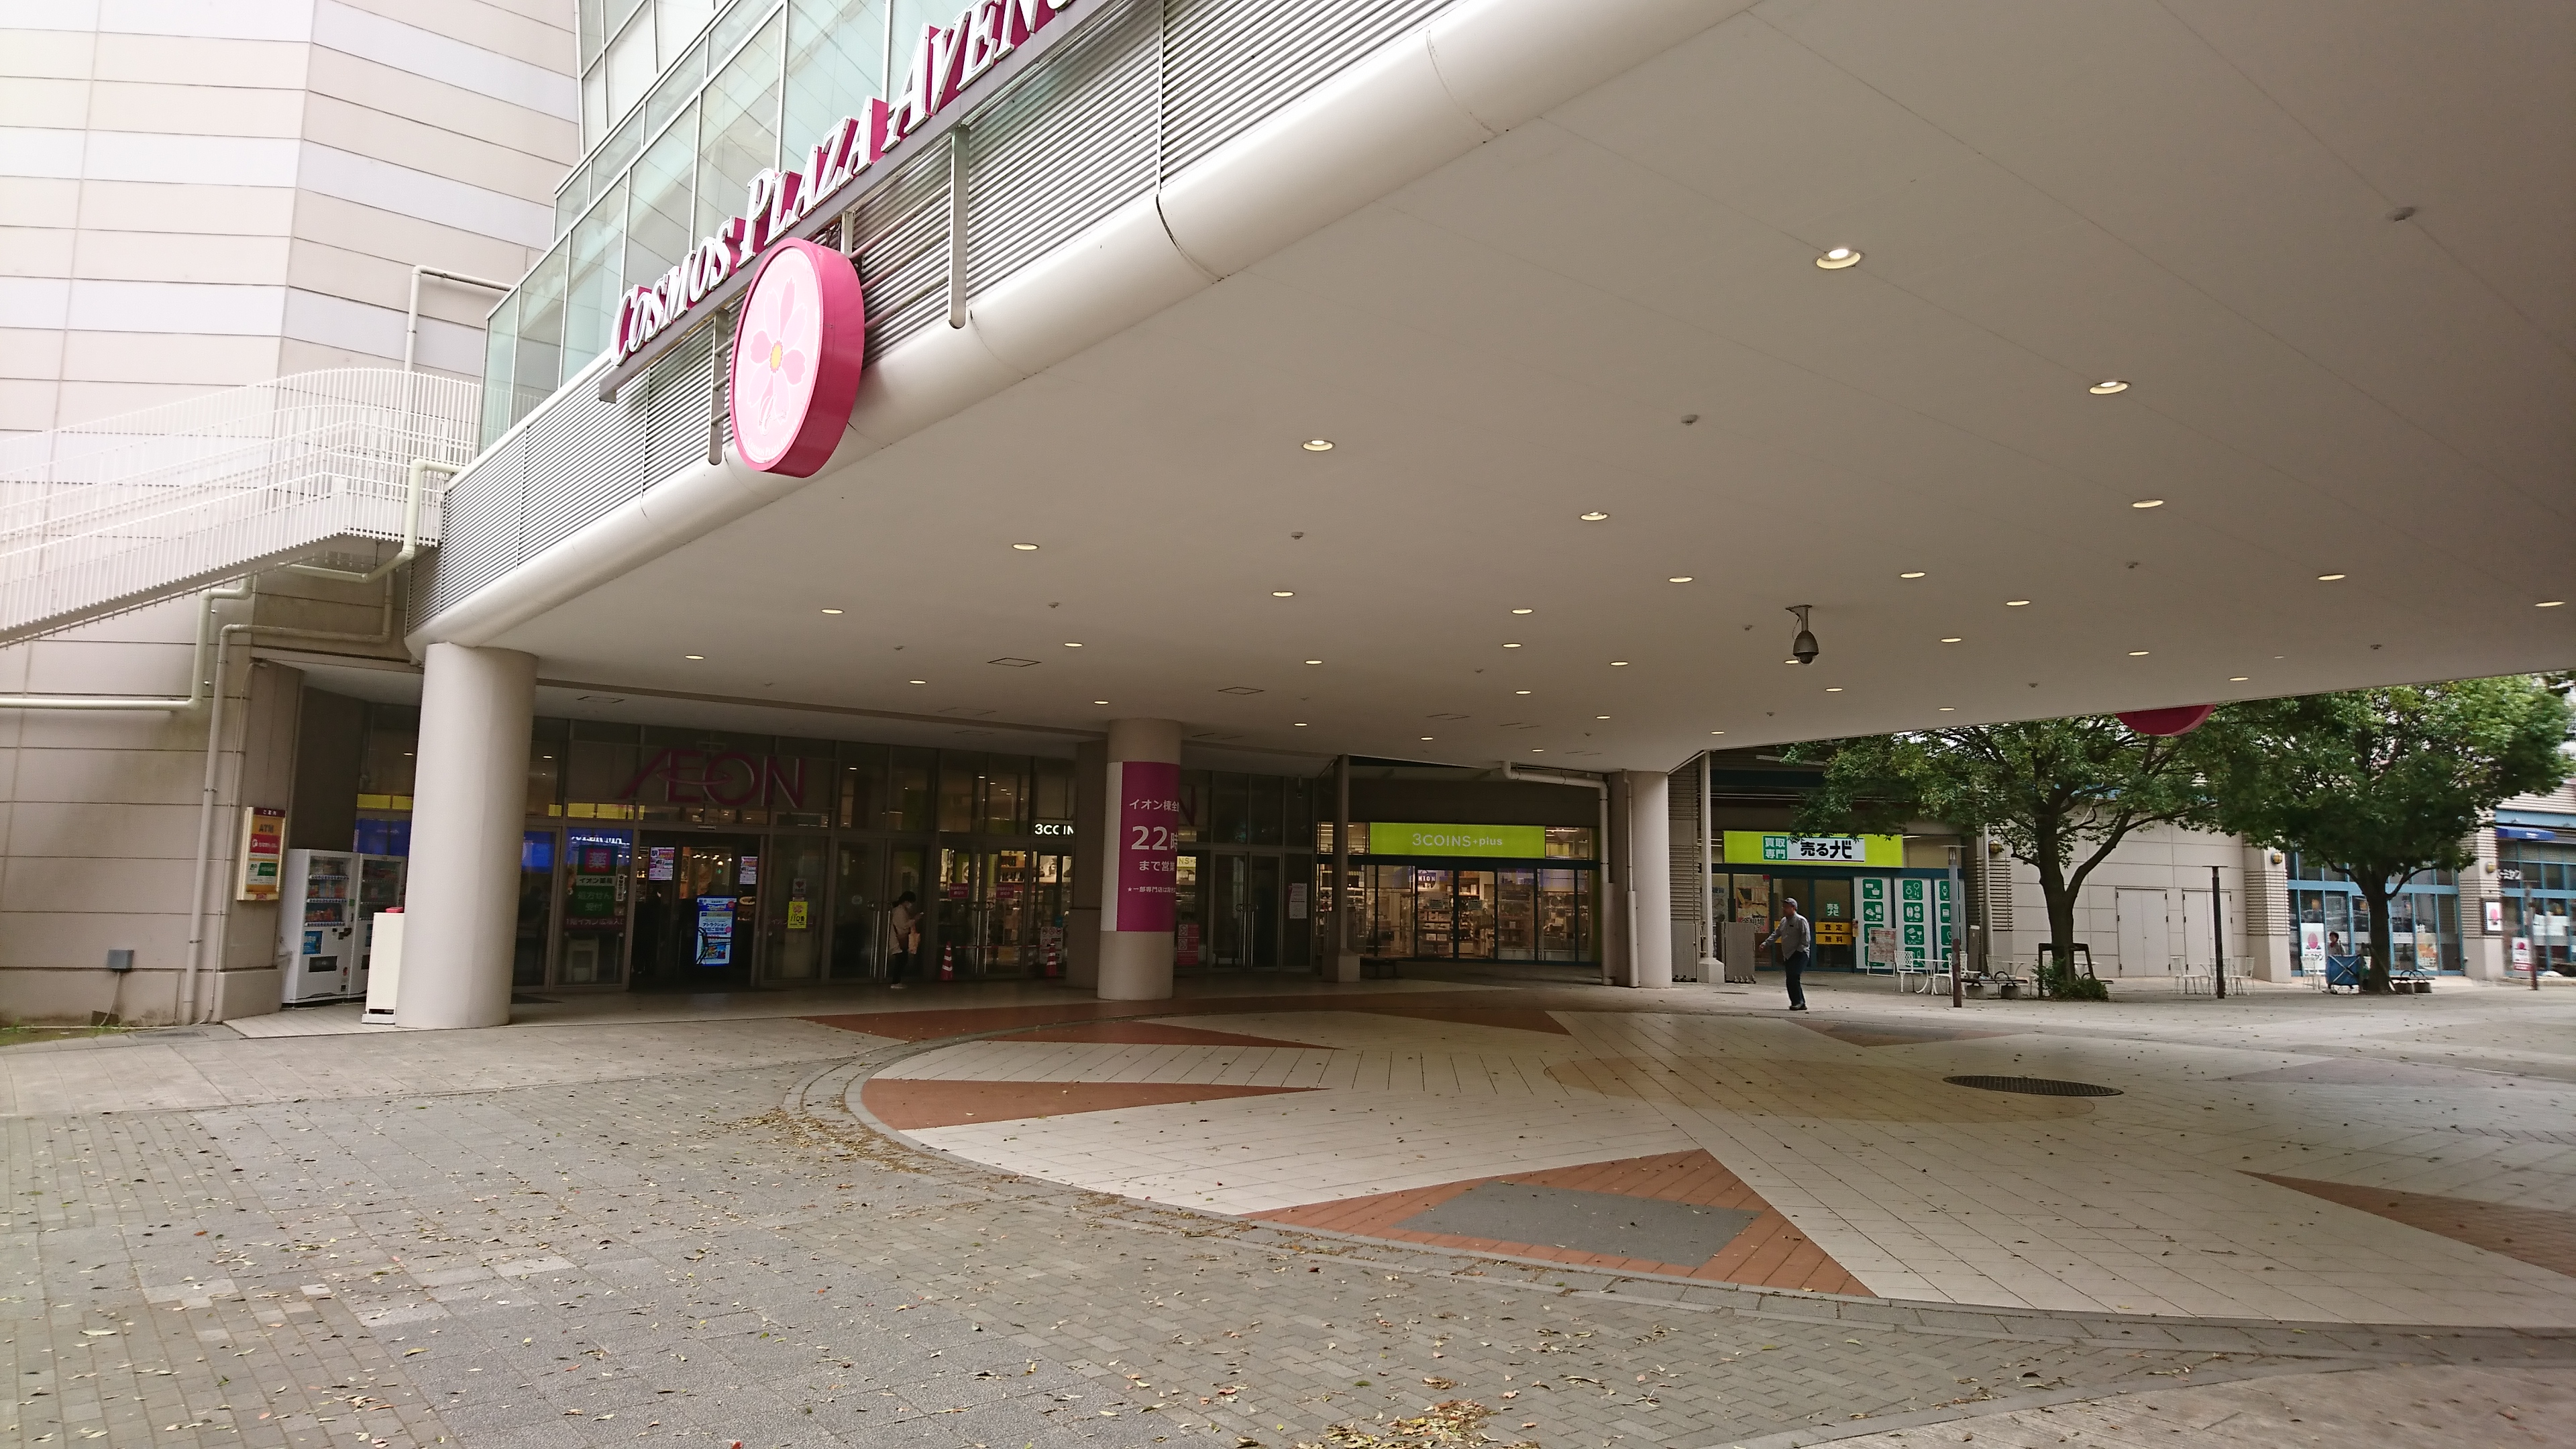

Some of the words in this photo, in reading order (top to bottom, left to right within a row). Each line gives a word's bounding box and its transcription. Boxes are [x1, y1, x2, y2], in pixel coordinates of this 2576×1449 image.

[610, 215, 735, 366] COSMOS
[737, 96, 874, 268] PLAZA
[1765, 838, 1786, 847] 買取
[1801, 840, 1852, 859] 売るナビ
[1765, 849, 1786, 859] 専門
